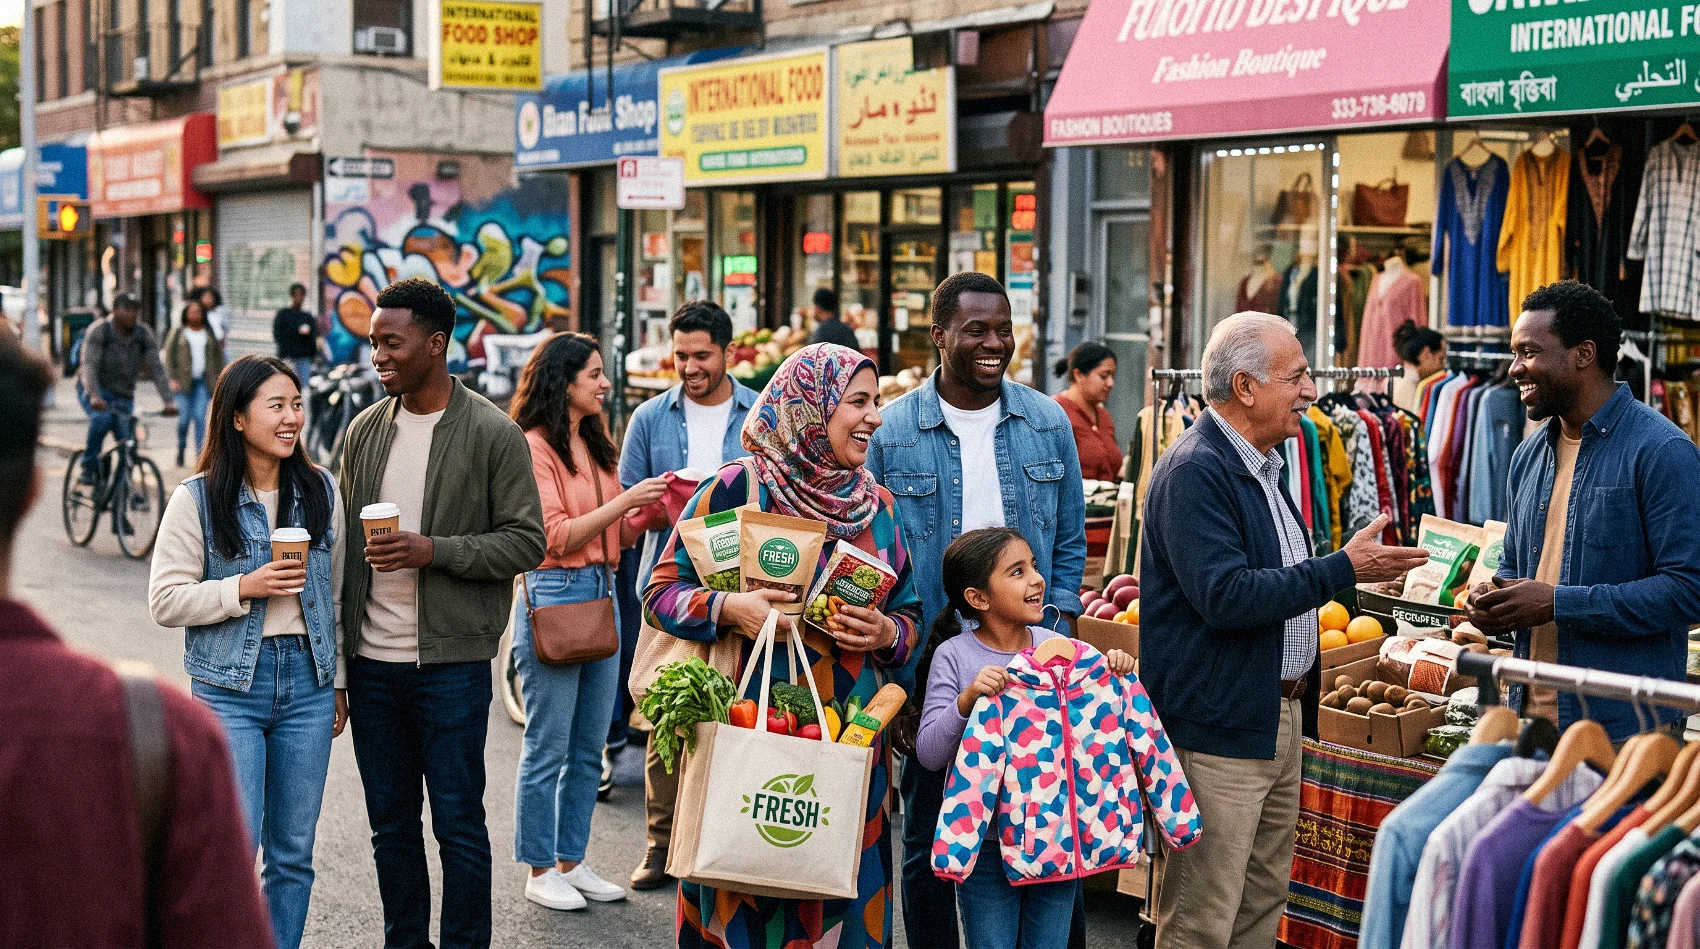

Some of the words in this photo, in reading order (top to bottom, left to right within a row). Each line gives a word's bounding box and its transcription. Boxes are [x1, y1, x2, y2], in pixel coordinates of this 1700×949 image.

[444, 6, 537, 23] INTERNATIONAL
[1510, 8, 1673, 53] INTERNATIONAL
[443, 23, 487, 44] FOOD
[494, 26, 537, 46] SHOP
[1151, 51, 1231, 84] Fashion
[1231, 43, 1327, 79] Boutique
[688, 71, 785, 115] INTERNATIONAL
[788, 63, 825, 103] FOOD
[614, 94, 657, 135] Shop
[1050, 115, 1101, 139] FASHION
[1102, 111, 1173, 136] BOUTIQUES
[762, 549, 795, 566] FRESH
[752, 793, 819, 828] FRESH
